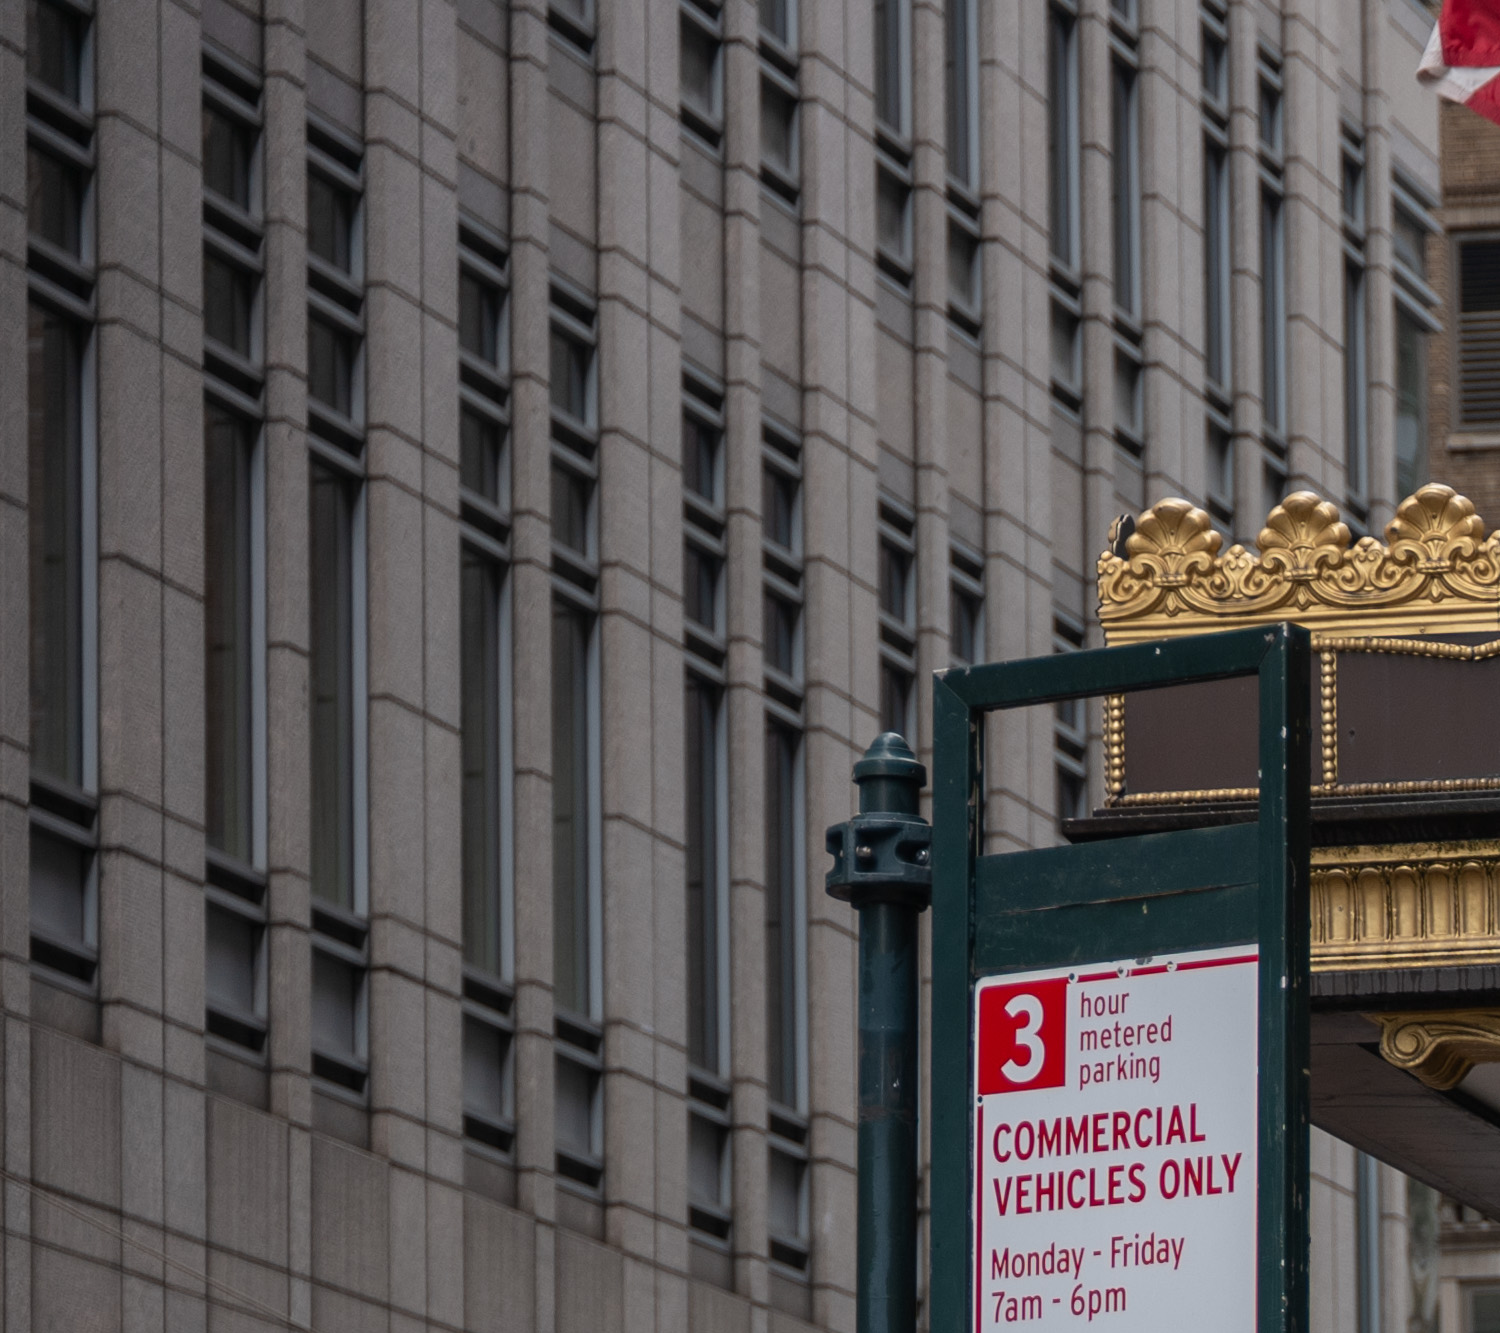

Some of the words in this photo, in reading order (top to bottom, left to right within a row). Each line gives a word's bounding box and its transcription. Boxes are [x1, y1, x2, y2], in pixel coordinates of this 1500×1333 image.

[1080, 991, 1129, 1017] hour
[1000, 994, 1045, 1083] 3
[1079, 1014, 1172, 1051] metered
[1079, 1053, 1160, 1091] parking
[992, 1103, 1206, 1163] COMMERCIAL
[993, 1163, 1147, 1216] VEHICLES
[1159, 1152, 1242, 1200] ONLY
[992, 1243, 1085, 1280] Monday
[1111, 1232, 1185, 1270] Friday
[992, 1293, 1042, 1323] 7am
[1070, 1284, 1126, 1322] 6pm
